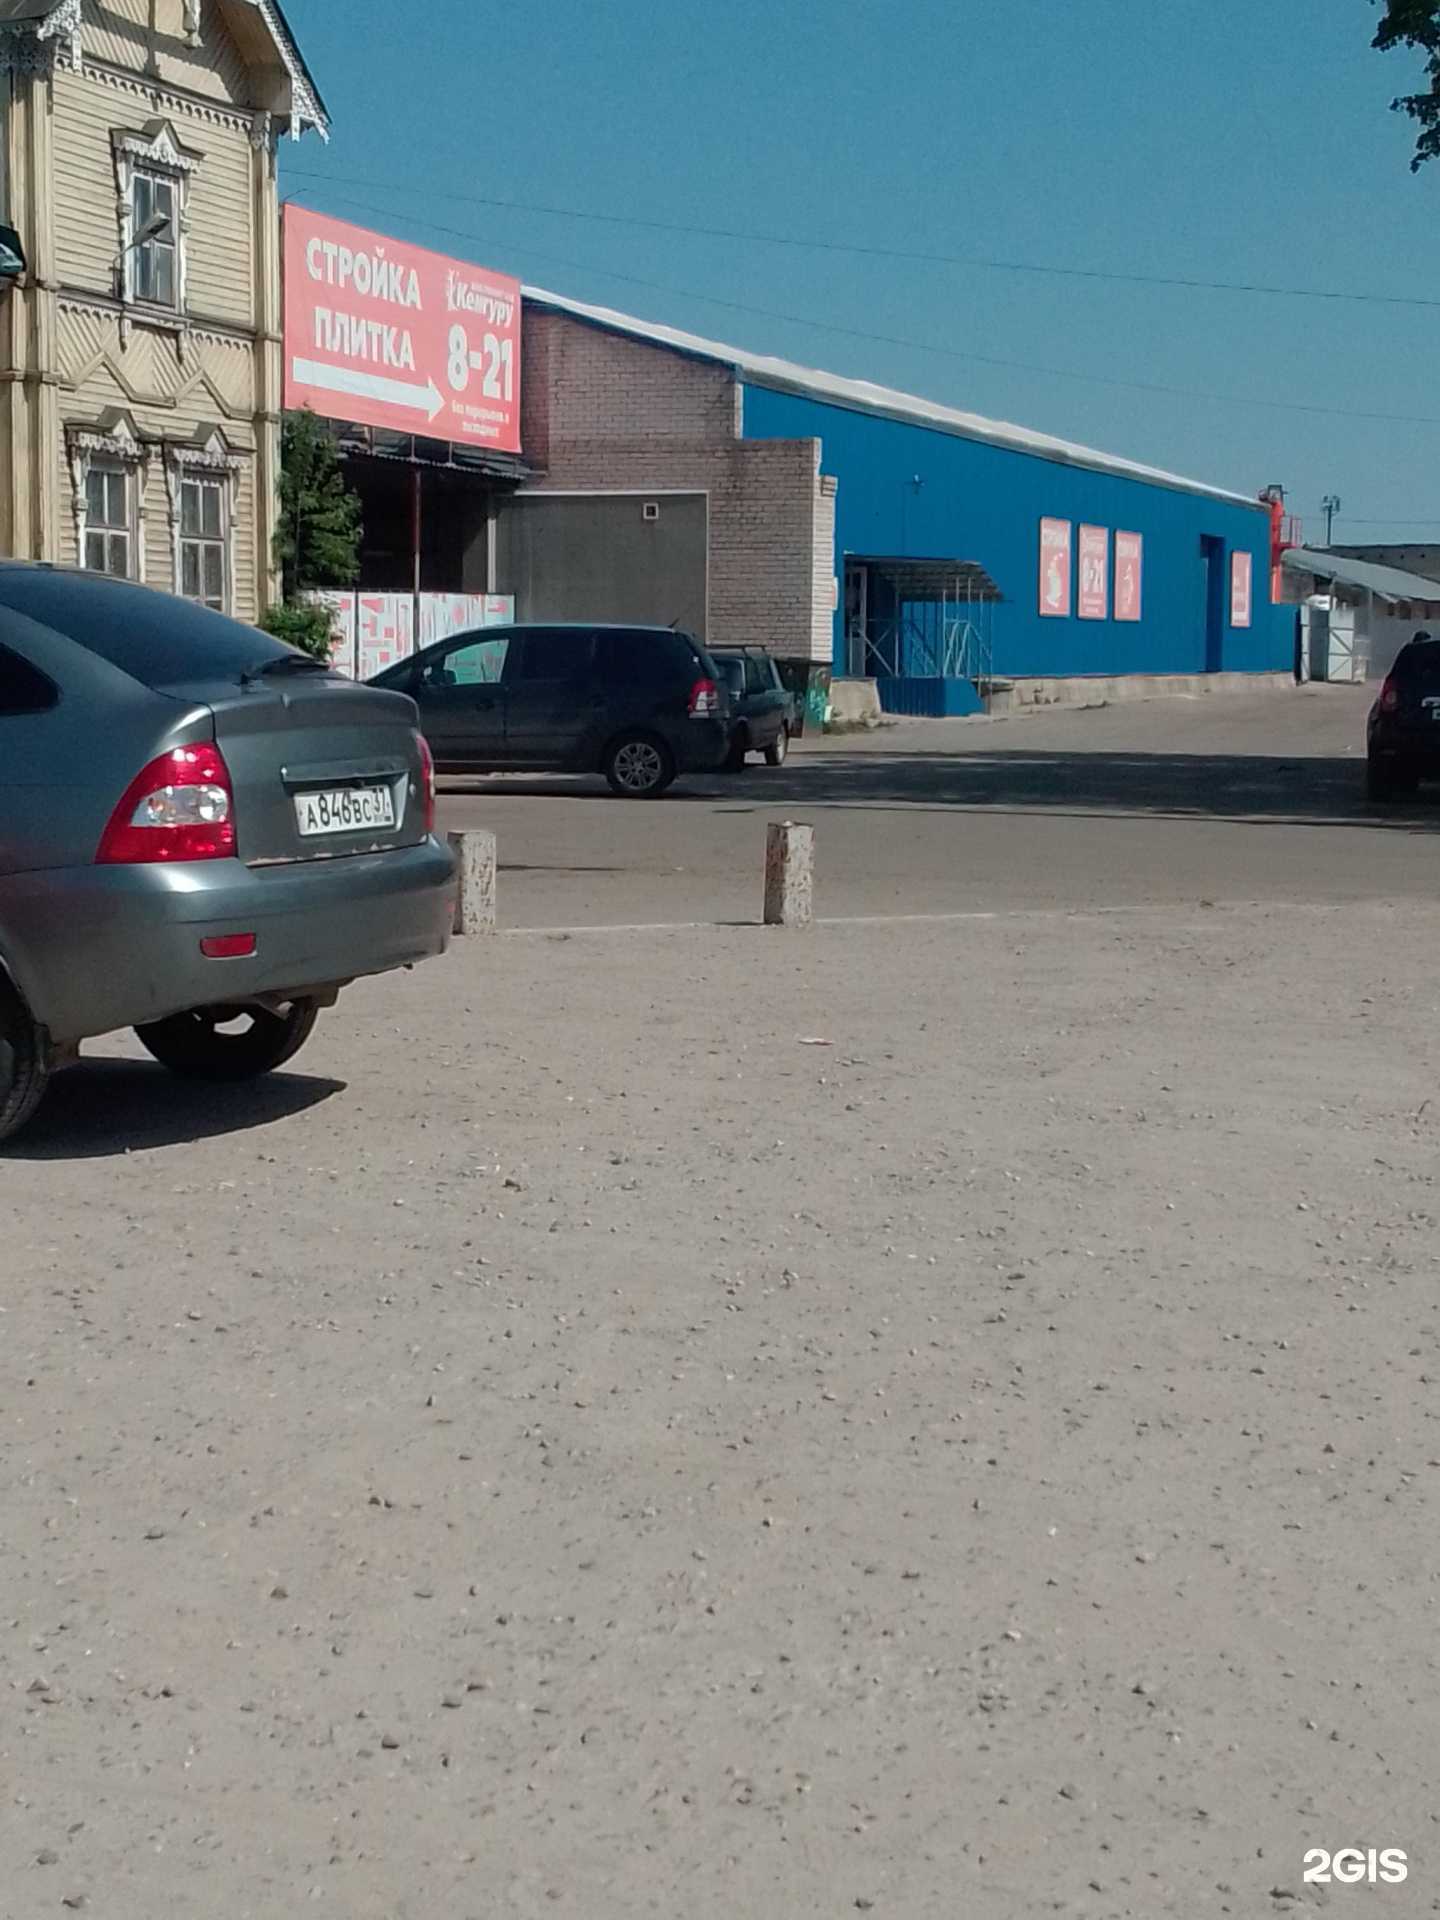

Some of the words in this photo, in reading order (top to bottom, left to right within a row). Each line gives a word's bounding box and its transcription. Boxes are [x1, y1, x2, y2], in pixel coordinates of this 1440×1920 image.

[306, 237, 423, 310] СТРОЙКА
[315, 306, 416, 372] ПЛИТКА
[448, 324, 513, 402] 8-21
